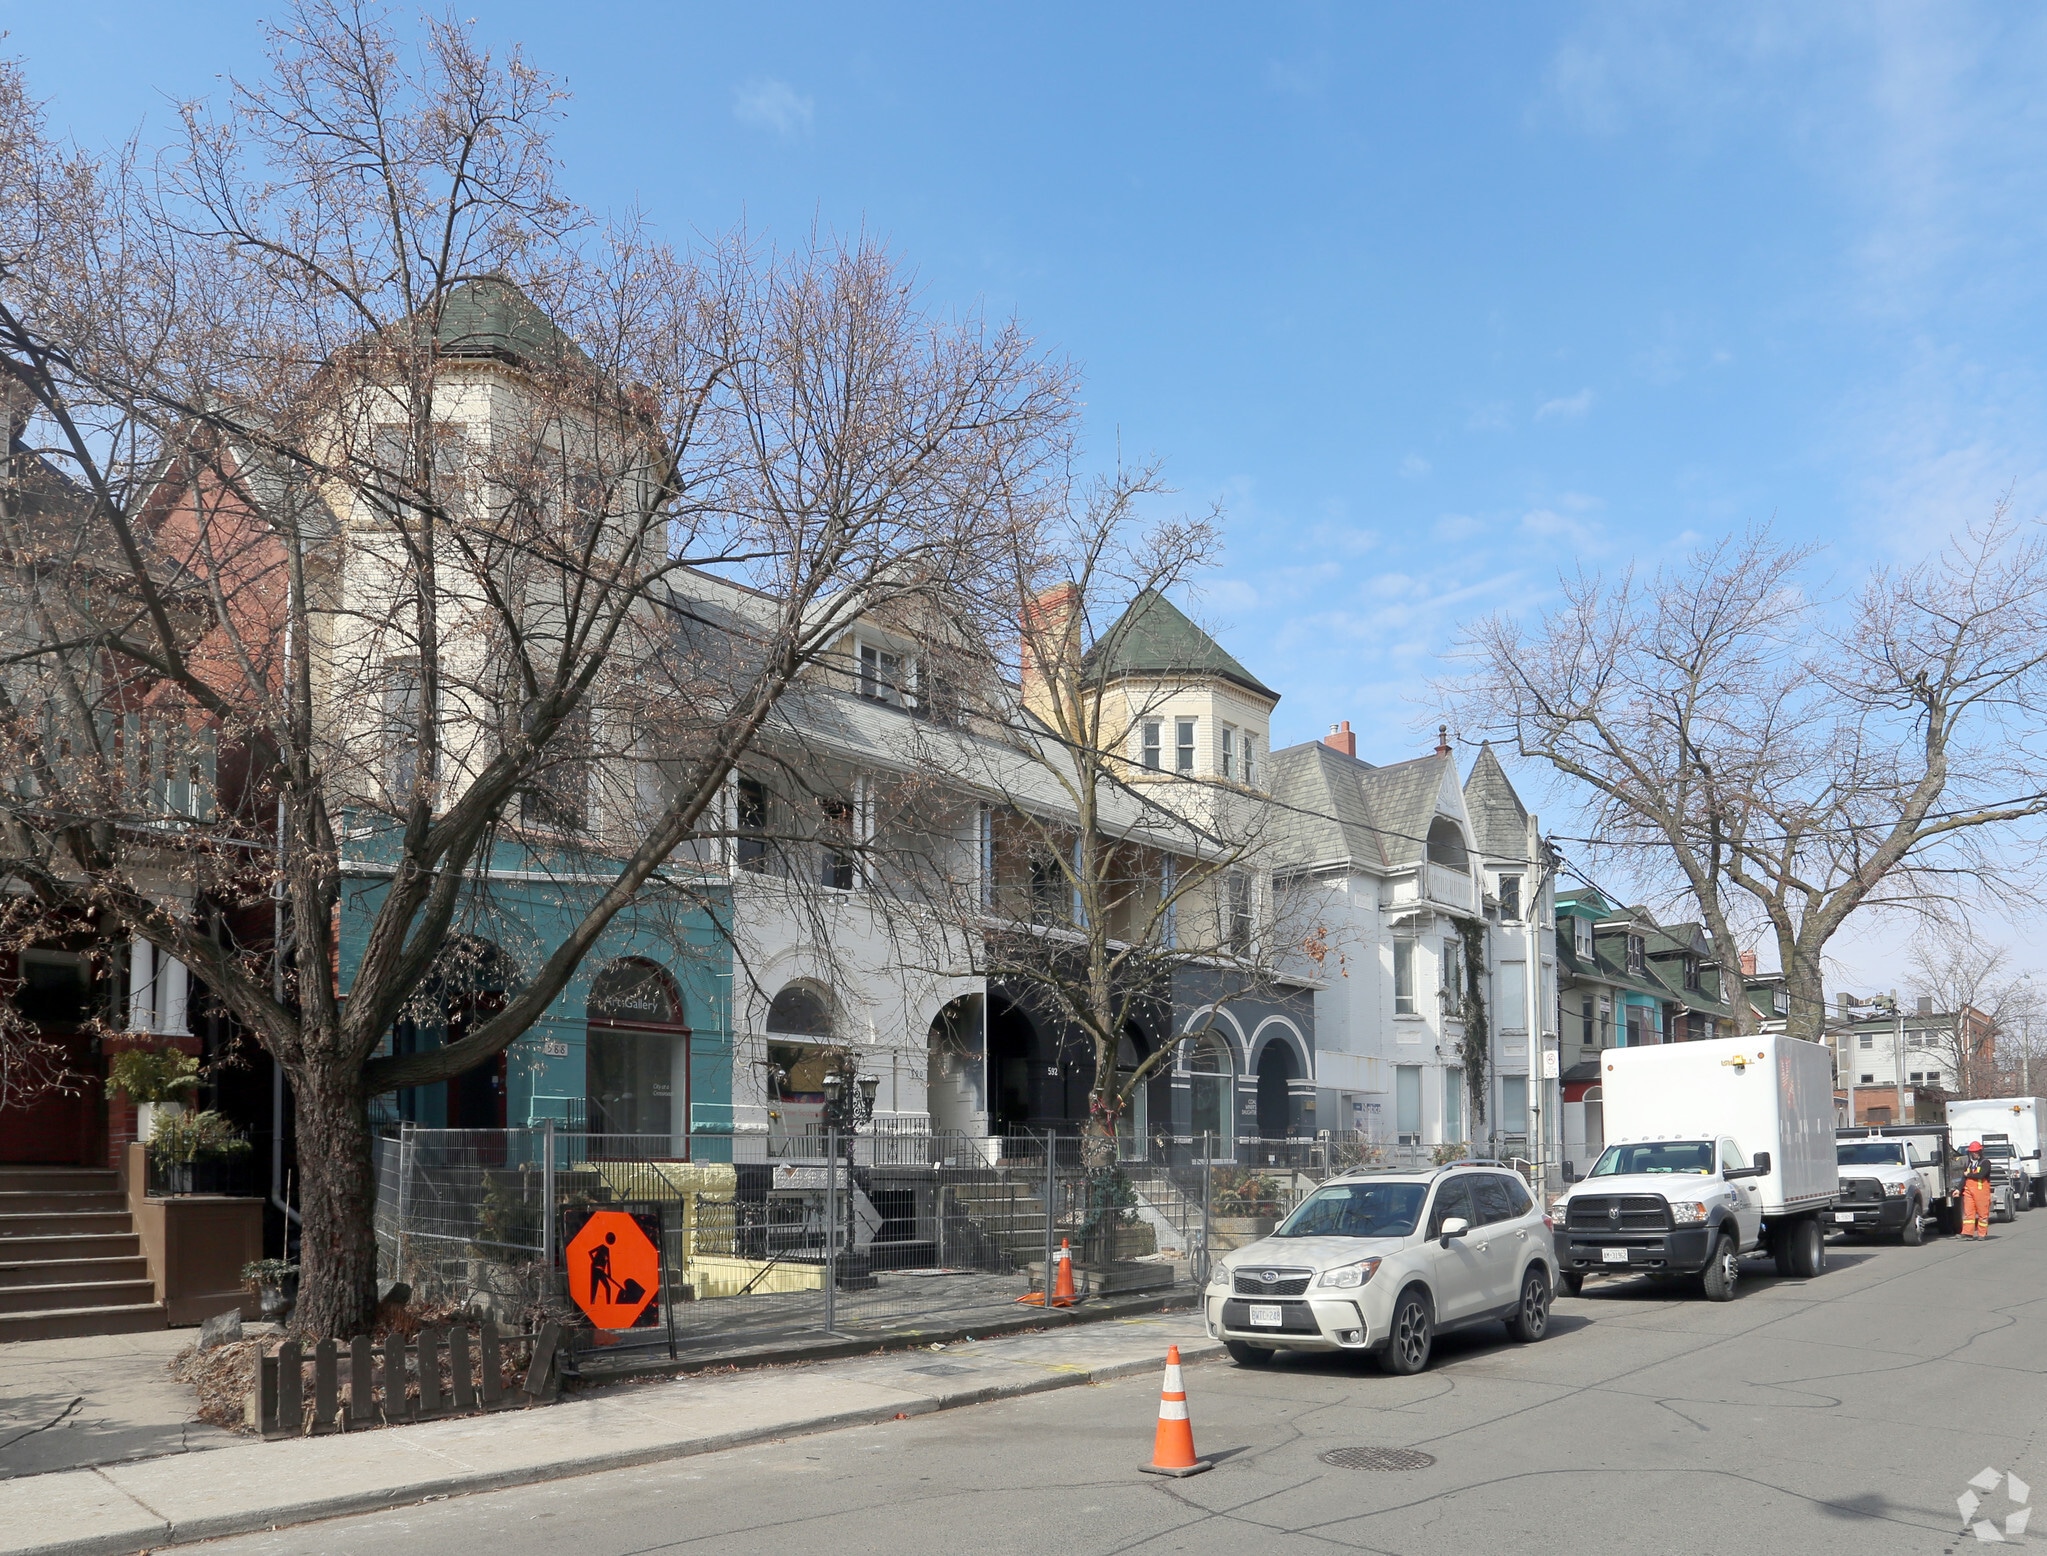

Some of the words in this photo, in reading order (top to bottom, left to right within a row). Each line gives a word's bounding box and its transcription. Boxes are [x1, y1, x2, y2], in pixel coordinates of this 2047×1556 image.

[604, 995, 621, 1008] Art
[624, 996, 658, 1014] Gallery
[547, 1044, 566, 1055] 588
[1047, 1066, 1058, 1076] 592
